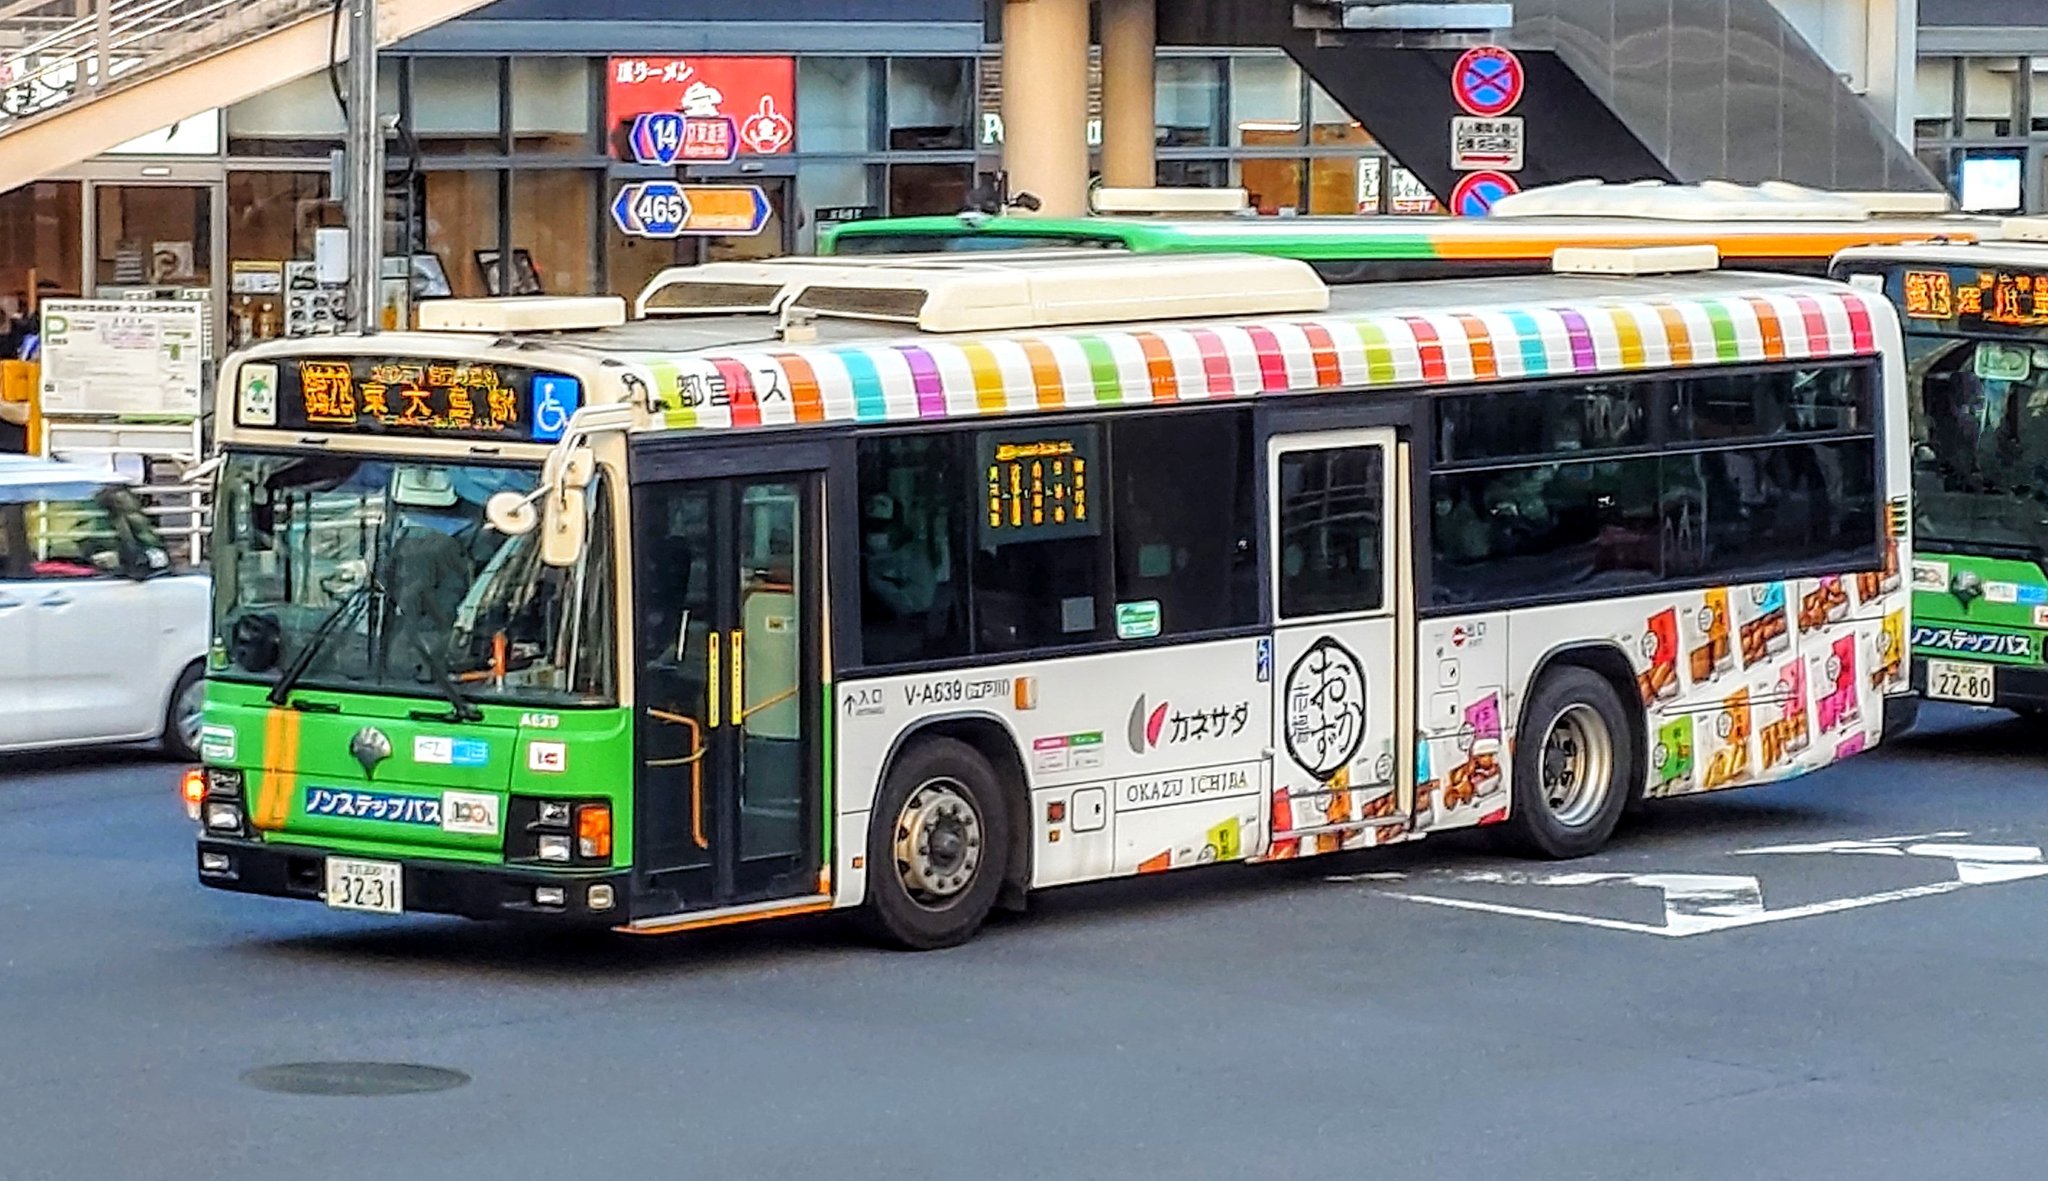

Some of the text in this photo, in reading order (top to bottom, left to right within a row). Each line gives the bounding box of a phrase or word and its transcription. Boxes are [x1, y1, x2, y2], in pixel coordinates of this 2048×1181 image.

[652, 118, 678, 151] 14
[638, 196, 683, 223] 465
[677, 368, 787, 408] 都営バス
[1912, 627, 2031, 656] ノンステップバス
[1169, 700, 1248, 744] カネサダ
[1126, 771, 1248, 802] OKAZU ICHIBA
[307, 789, 441, 823] ノンステップバス
